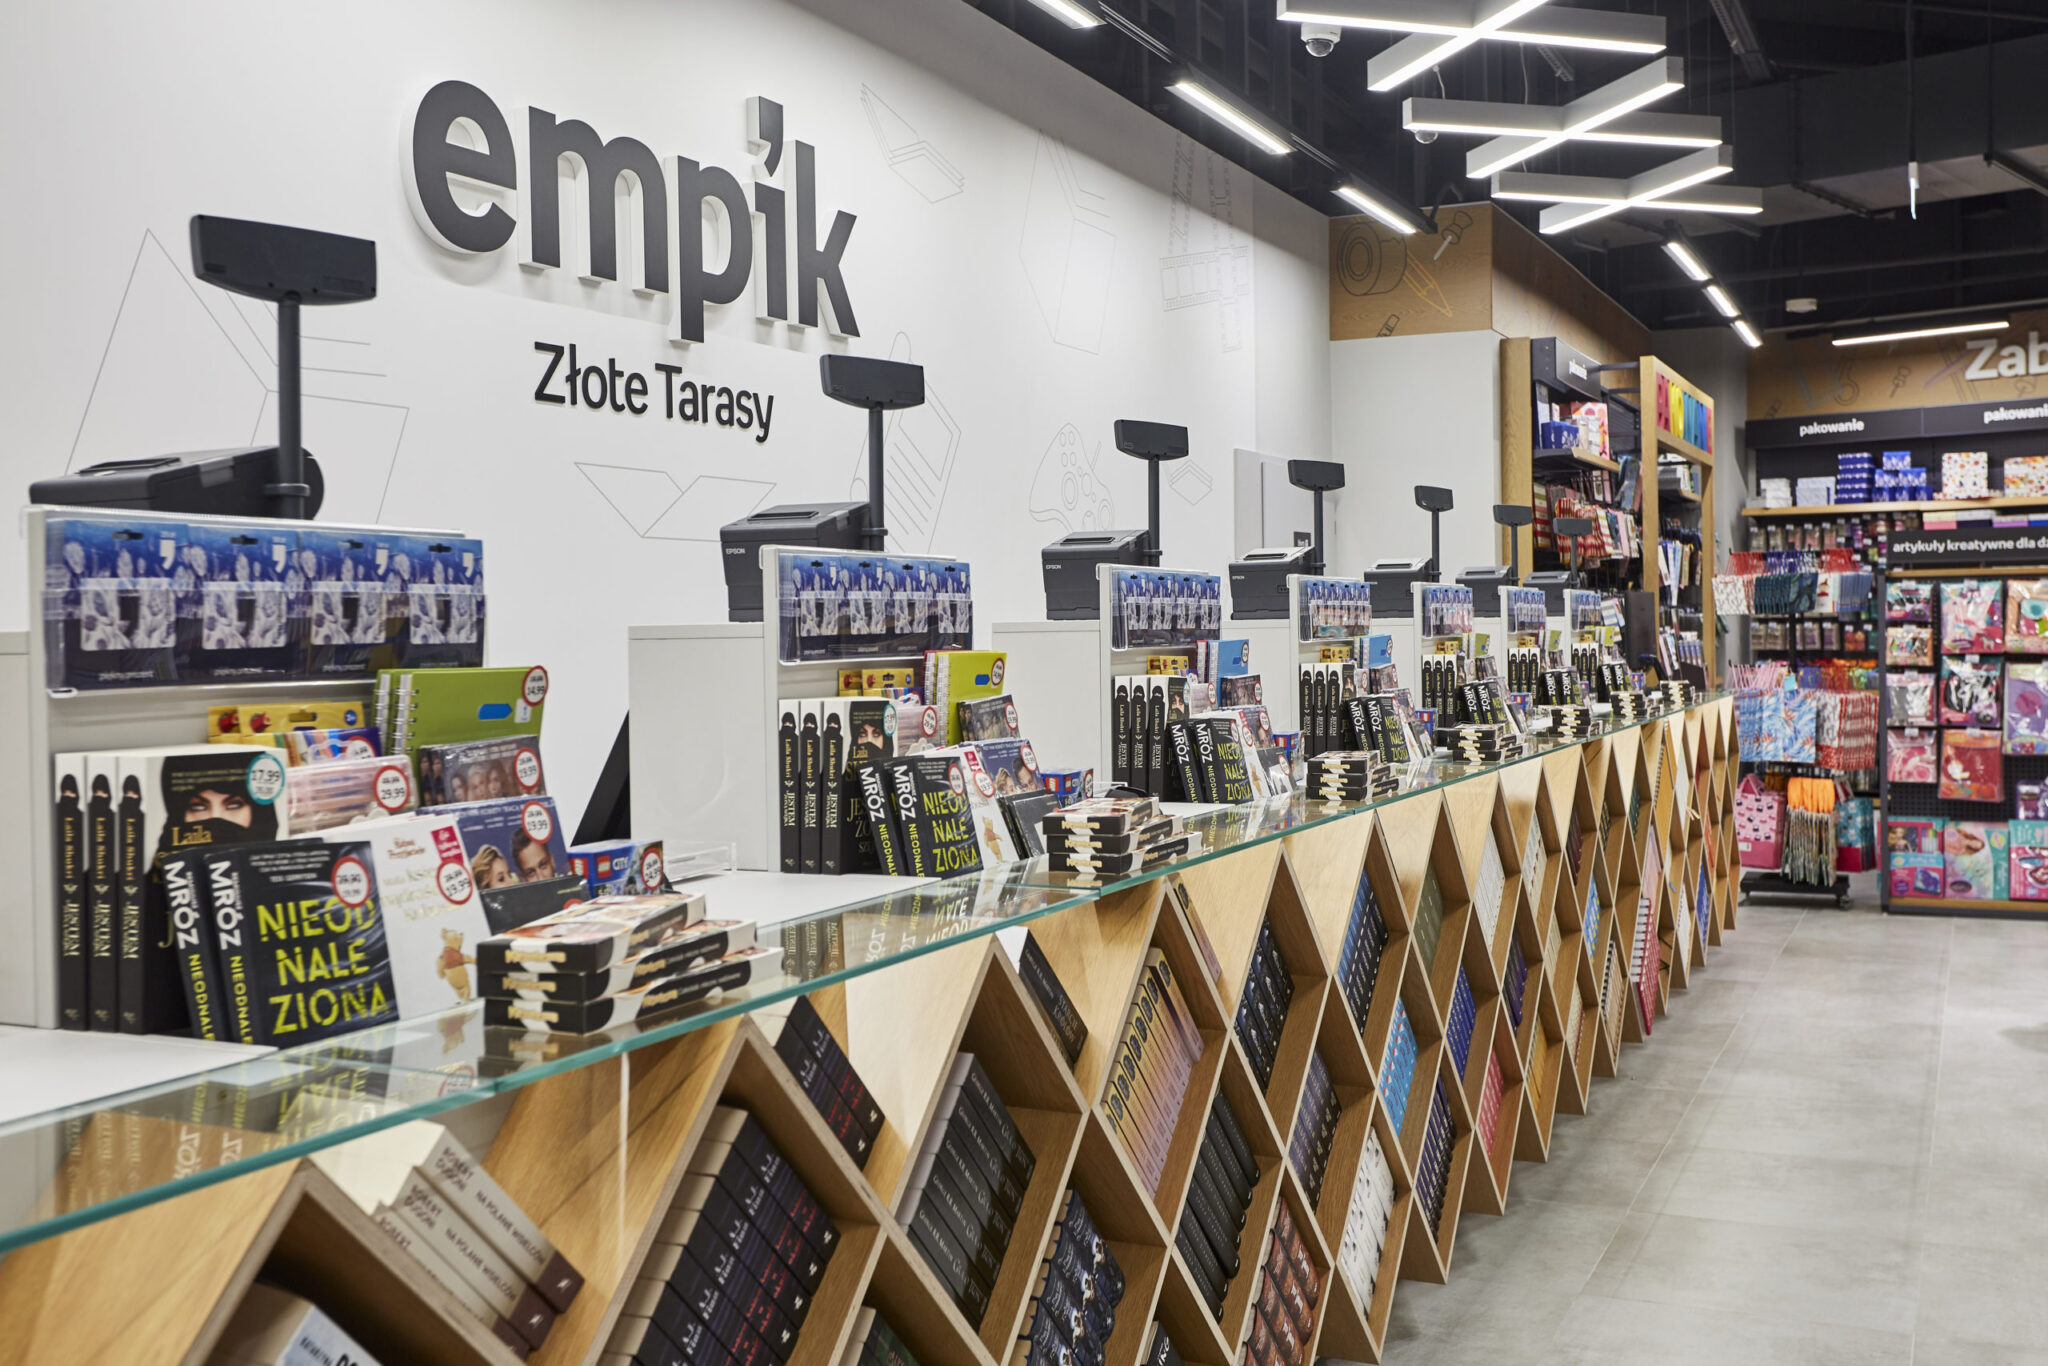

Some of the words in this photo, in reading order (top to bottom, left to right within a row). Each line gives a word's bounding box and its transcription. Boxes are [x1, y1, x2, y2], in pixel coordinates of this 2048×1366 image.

[534, 341, 649, 415] Złote
[655, 362, 774, 443] Tarasy
[1800, 418, 1865, 437] pakowanie
[1893, 539, 1946, 554] artykuły
[1947, 537, 2014, 552] kreatywne
[2016, 536, 2035, 549] dla
[1368, 701, 1382, 732] MRÓZ
[1464, 686, 1477, 712] MRÓZ
[1478, 685, 1490, 712] MRÓZ
[1350, 701, 1364, 733] MRÓZ
[1172, 724, 1189, 764] MRÓZ
[1196, 723, 1214, 764] MRÓZ
[787, 790, 796, 826] JESTEM
[808, 792, 816, 828] JESTEM
[830, 792, 838, 828] JESTEM
[860, 766, 885, 822] MRÓZ
[893, 764, 917, 821] MRÓZ
[932, 817, 969, 844] NALE
[932, 844, 979, 872] ZIONA
[164, 860, 200, 950] MRÓZ
[209, 860, 245, 950] MRÓZ
[275, 938, 371, 986] NALE
[268, 981, 390, 1035] ZIONA
